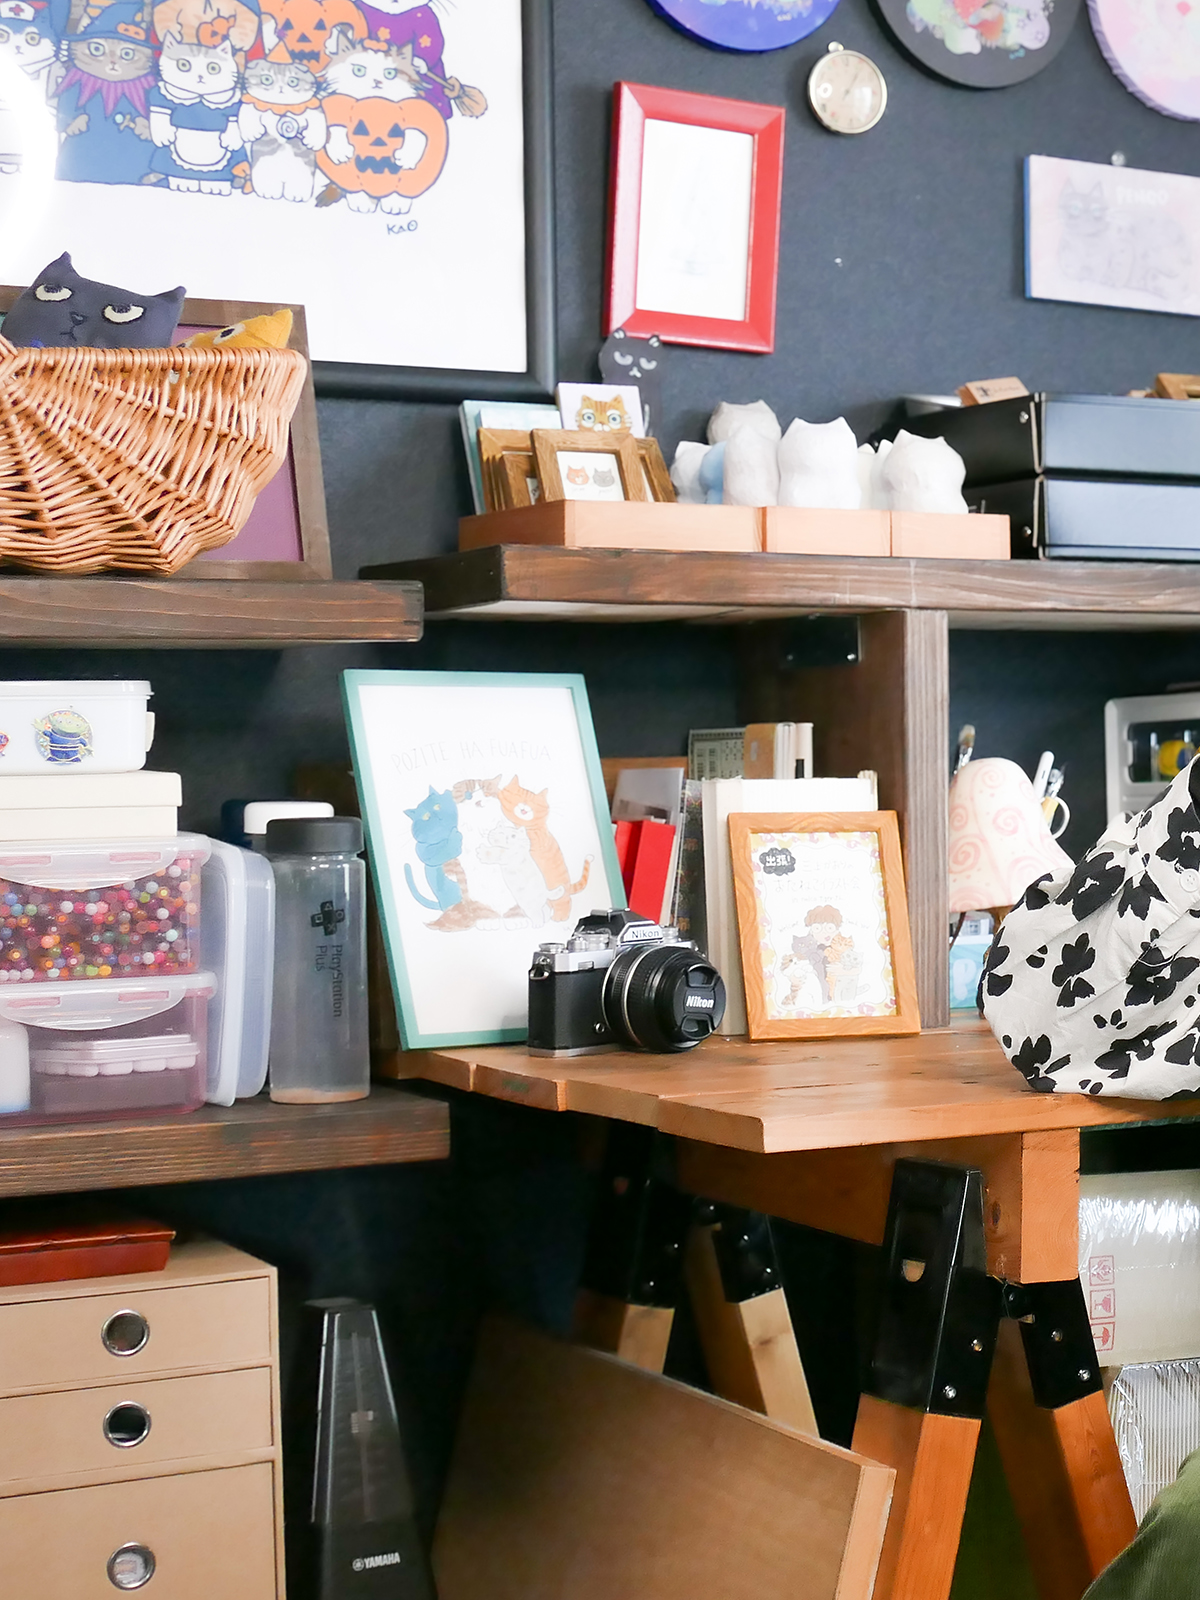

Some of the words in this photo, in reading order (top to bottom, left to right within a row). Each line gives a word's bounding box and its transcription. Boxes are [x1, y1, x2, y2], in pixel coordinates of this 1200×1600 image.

[391, 741, 449, 775] POZITE
[459, 741, 484, 759] HA
[490, 738, 551, 761] FUAFUA
[631, 929, 660, 939] Nikon
[314, 945, 328, 972] Plus
[328, 945, 344, 1018] PlayStation
[685, 995, 715, 1009] Nikon
[364, 1552, 401, 1569] YAMAHA
